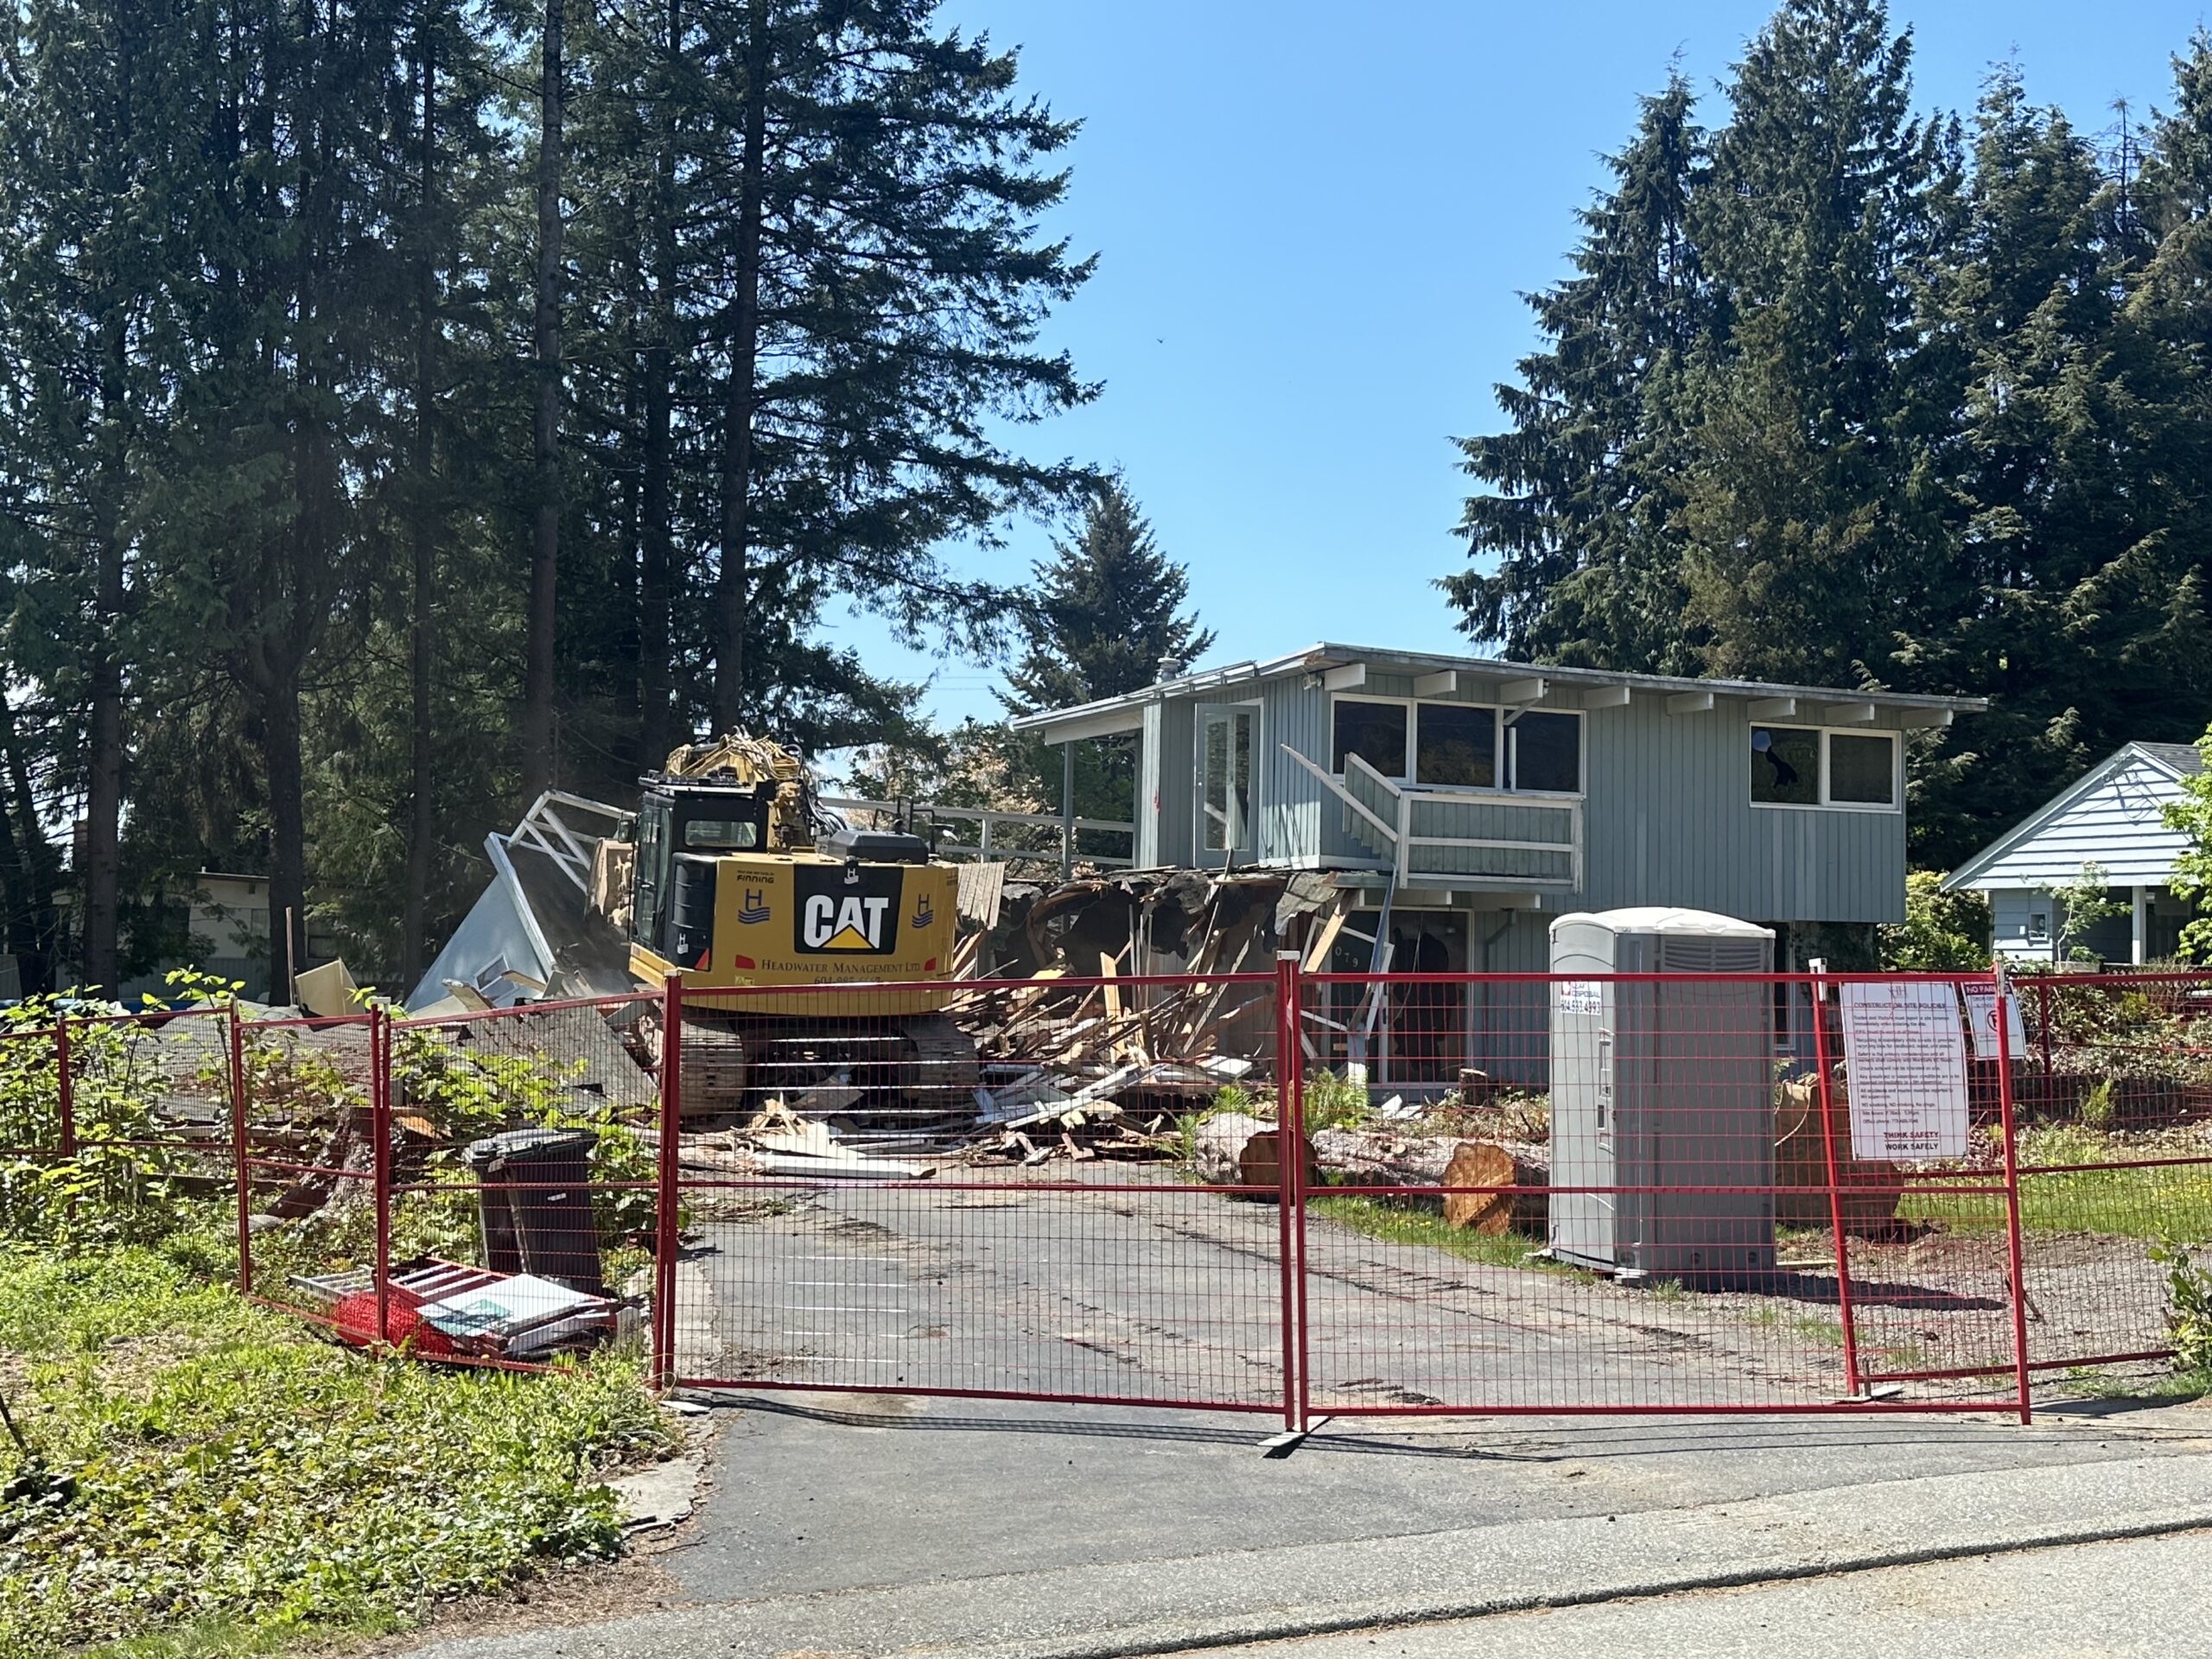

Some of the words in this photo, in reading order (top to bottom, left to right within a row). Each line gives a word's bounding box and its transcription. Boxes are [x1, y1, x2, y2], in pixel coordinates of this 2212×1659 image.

[737, 874, 774, 884] FINNING
[804, 894, 889, 950] CAT
[761, 959, 828, 972] HEADWATER
[833, 962, 903, 974] MANAGEMENT
[1910, 1142, 1939, 1151] SAFELY
